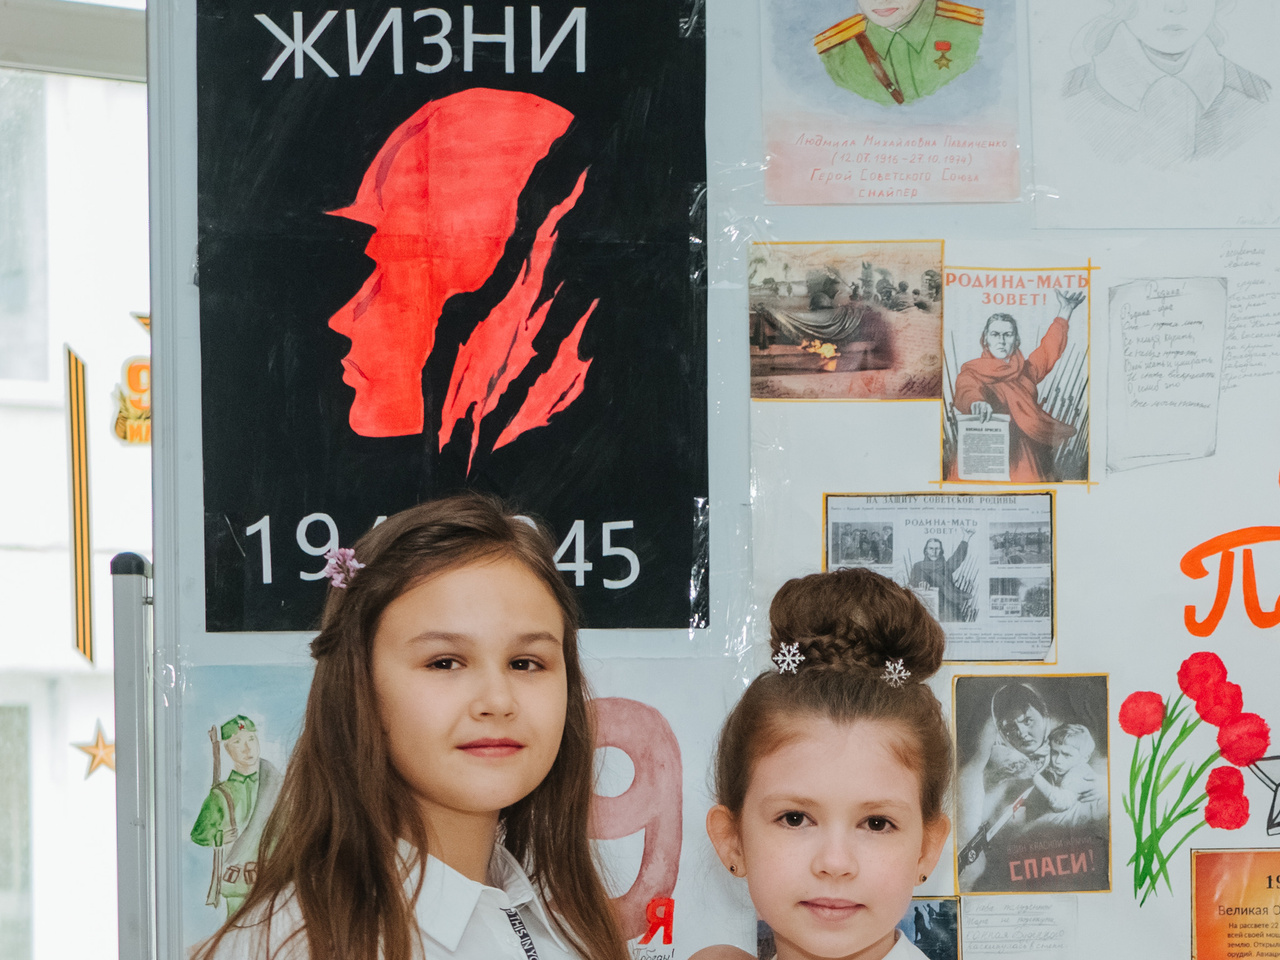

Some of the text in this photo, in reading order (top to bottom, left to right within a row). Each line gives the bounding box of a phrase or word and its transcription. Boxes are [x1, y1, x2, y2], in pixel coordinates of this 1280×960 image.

[254, 4, 587, 81] ЖИЗНИ
[945, 273, 1089, 289] РОДИНА-МАТЬ
[981, 292, 1047, 306] ЗОВЕТ!
[904, 519, 978, 527] РОДИНА-МАТЬ
[1009, 849, 1095, 882] СПАСИ!
[1218, 904, 1269, 916] Великая
[510, 915, 527, 939] THIS
[521, 937, 533, 950] IN
